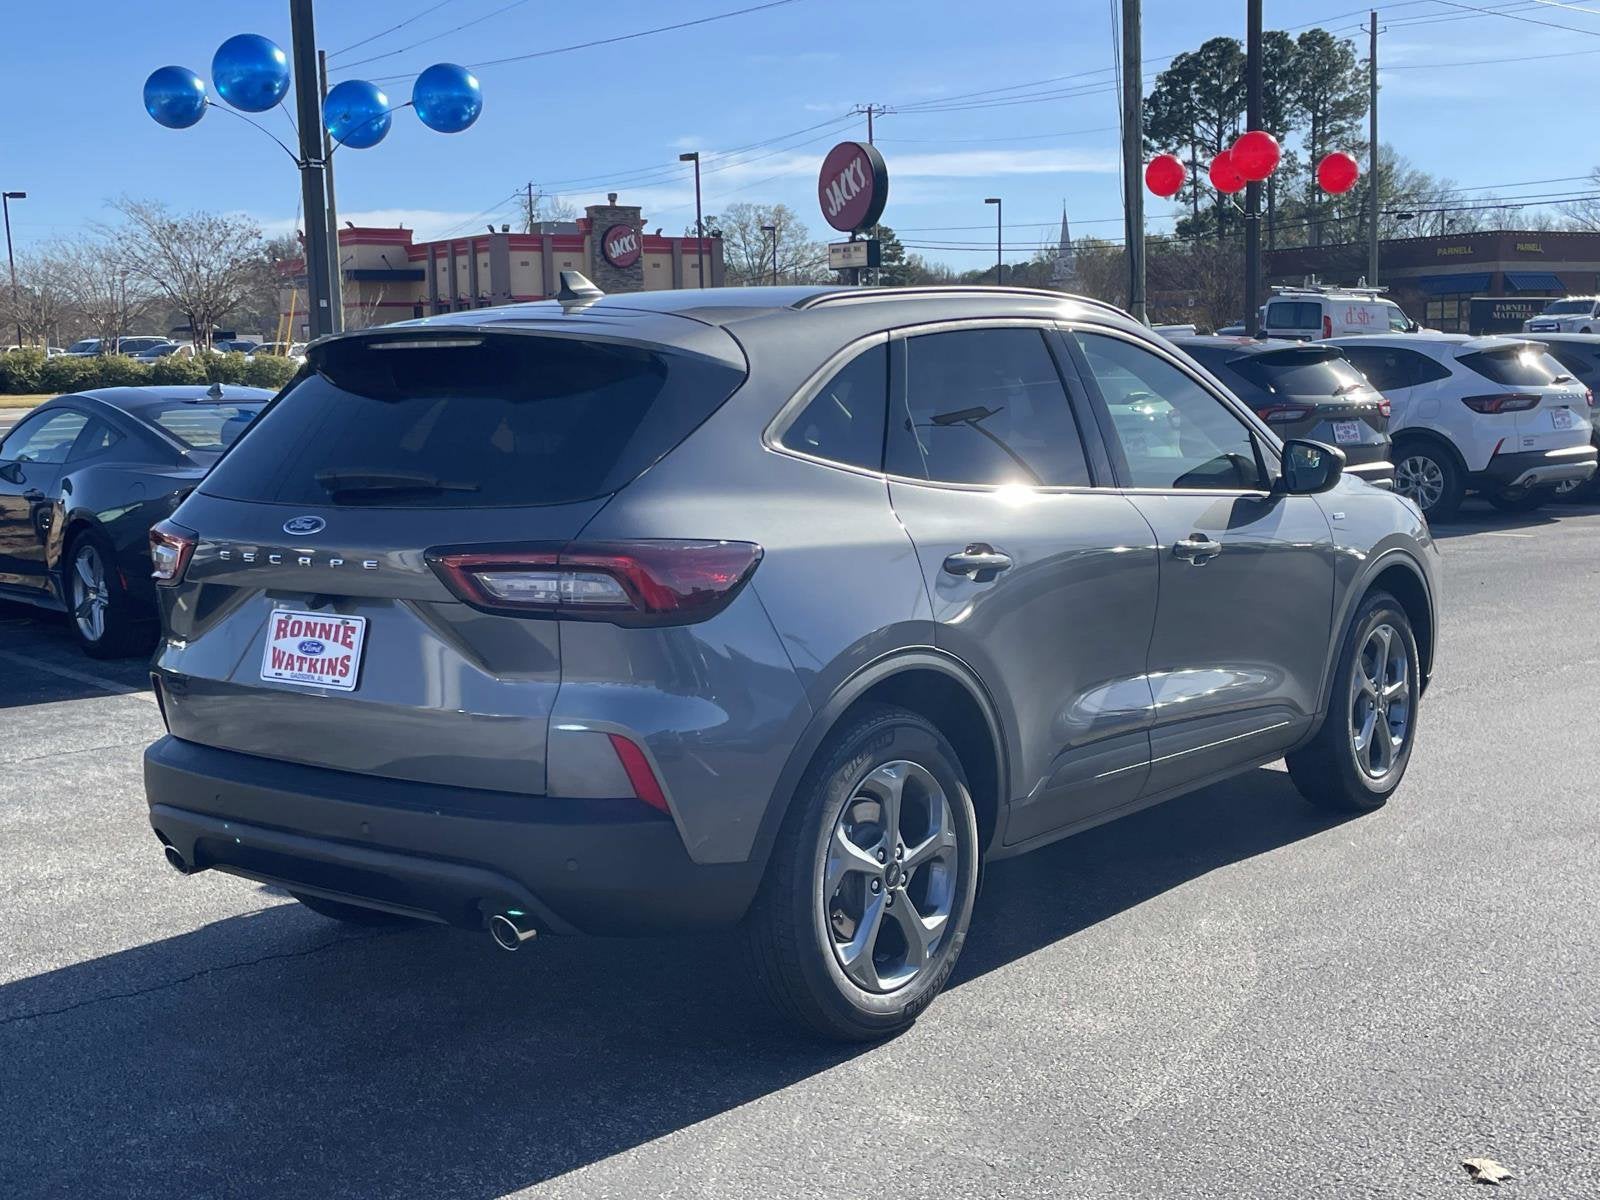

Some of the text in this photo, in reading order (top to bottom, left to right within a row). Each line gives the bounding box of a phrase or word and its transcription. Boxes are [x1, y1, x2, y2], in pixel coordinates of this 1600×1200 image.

[1437, 246, 1474, 256] PARNELL
[219, 550, 379, 570] ESCAPE
[274, 618, 357, 650] RONNIE
[271, 646, 352, 678] WATKINS
